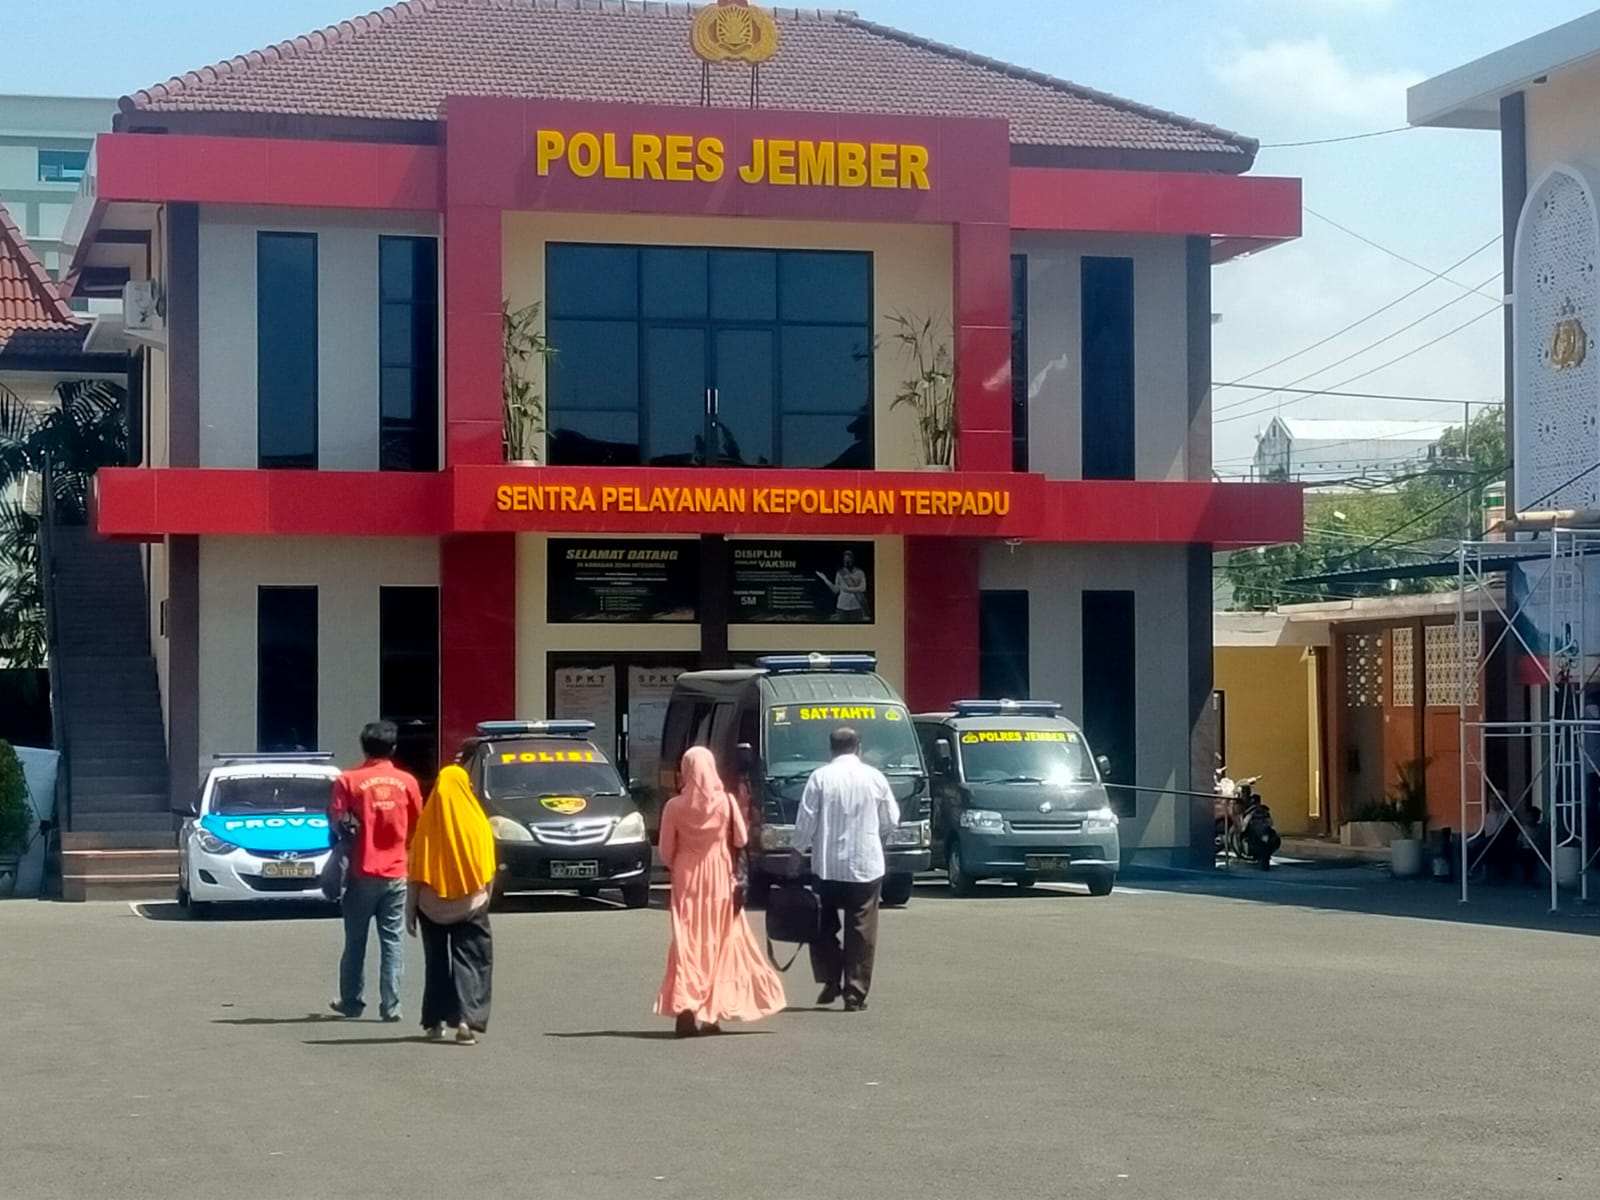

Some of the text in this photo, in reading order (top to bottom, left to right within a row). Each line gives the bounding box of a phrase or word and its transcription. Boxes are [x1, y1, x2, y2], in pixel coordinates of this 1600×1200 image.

[537, 130, 930, 190] POLRES JEMBER
[497, 486, 1010, 515] SENTRA PELAYANAN KEPOLISIAN TERPADU
[566, 549, 679, 560] SELAMAT DATANG
[734, 550, 782, 559] DISIPLIN
[759, 560, 796, 568] VAKSIN
[741, 596, 757, 605] 5M
[800, 708, 876, 720] SAT TAHTI
[978, 732, 1066, 742] POLRES JEMBER
[501, 750, 593, 764] POLISI
[225, 818, 329, 830] PROVO
